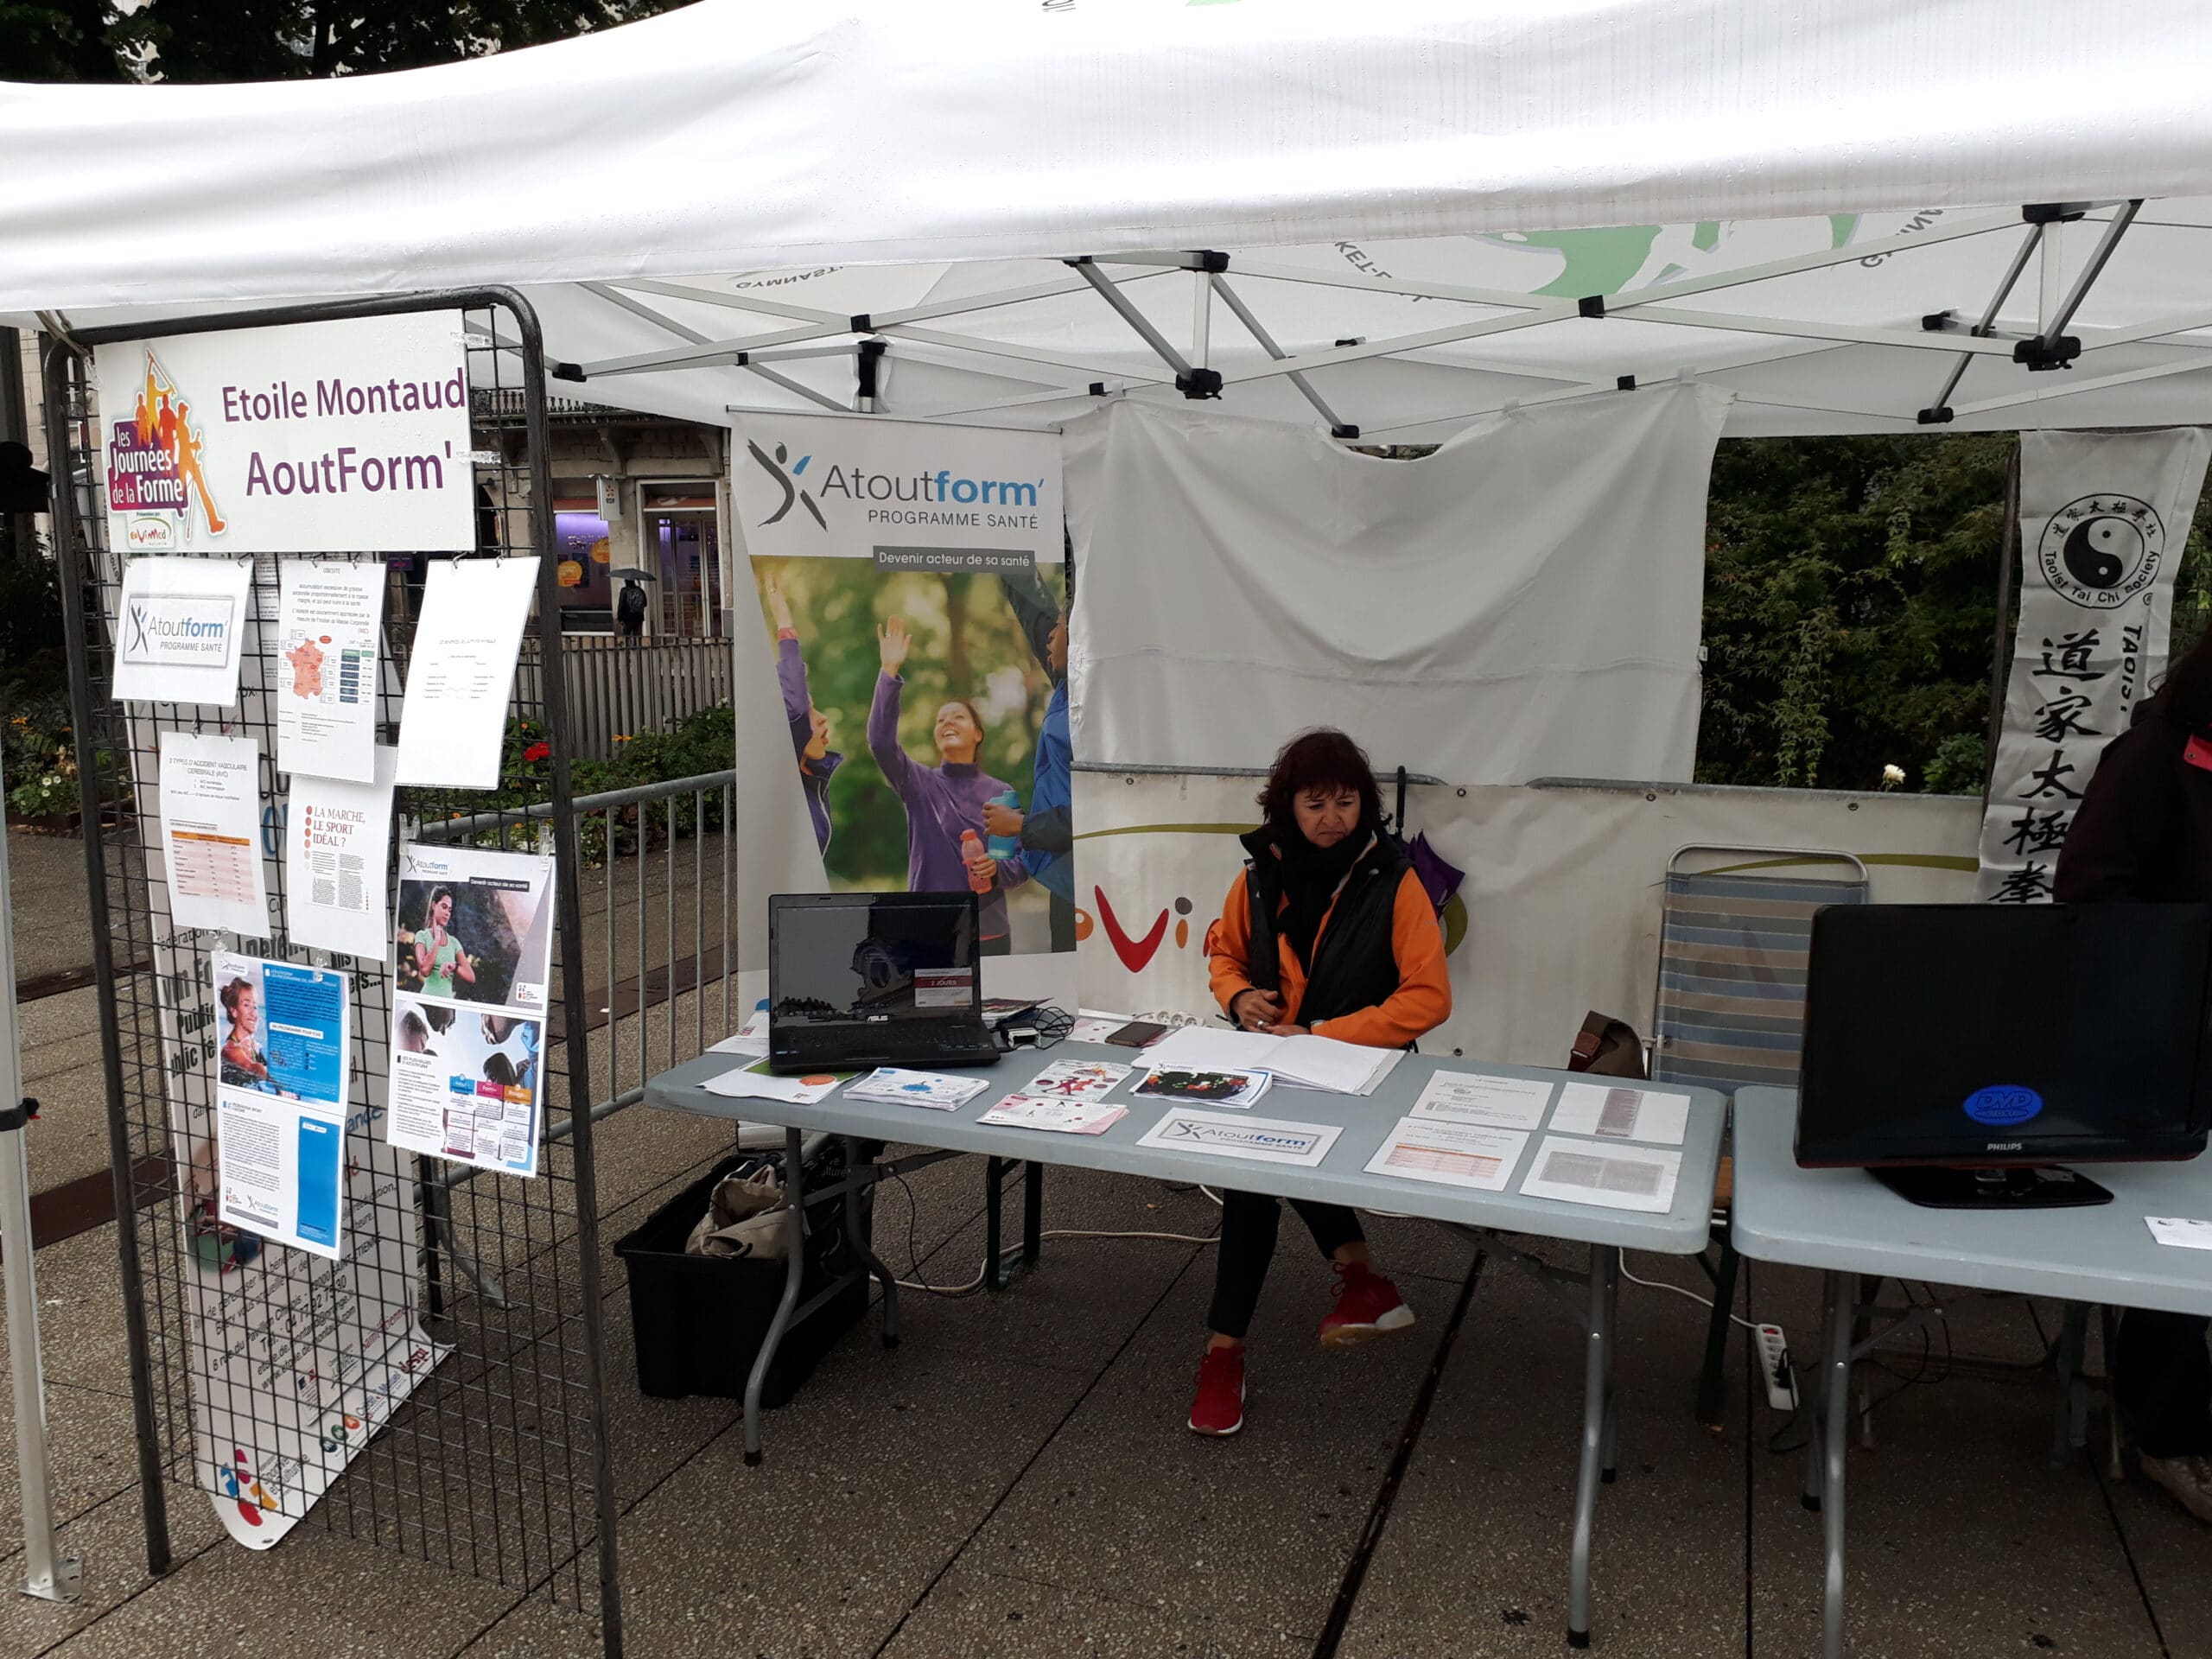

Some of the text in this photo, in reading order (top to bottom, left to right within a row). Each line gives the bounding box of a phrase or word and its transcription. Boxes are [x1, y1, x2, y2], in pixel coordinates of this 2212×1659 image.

[223, 367, 465, 423] Etoile Montaud
[117, 427, 130, 448] les
[112, 442, 173, 481] Journées
[246, 441, 452, 497] AoutForm'
[112, 474, 183, 504] de la Forme
[820, 464, 1045, 506] Atoutform'
[868, 510, 1039, 529] PROGRAMME SANTÉ
[879, 551, 1030, 567] Devenir acteur de sa santé
[2044, 550, 2160, 603] Taoist Tai Chi Society
[160, 641, 222, 652] PROGRAMME SANTÉ
[314, 806, 365, 824] LA MARCHE,
[313, 820, 354, 835] LE SPORT
[313, 832, 340, 847] IDÉAL
[1976, 1090, 2033, 1109] DVD
[1986, 1142, 2022, 1151] PHILIPS
